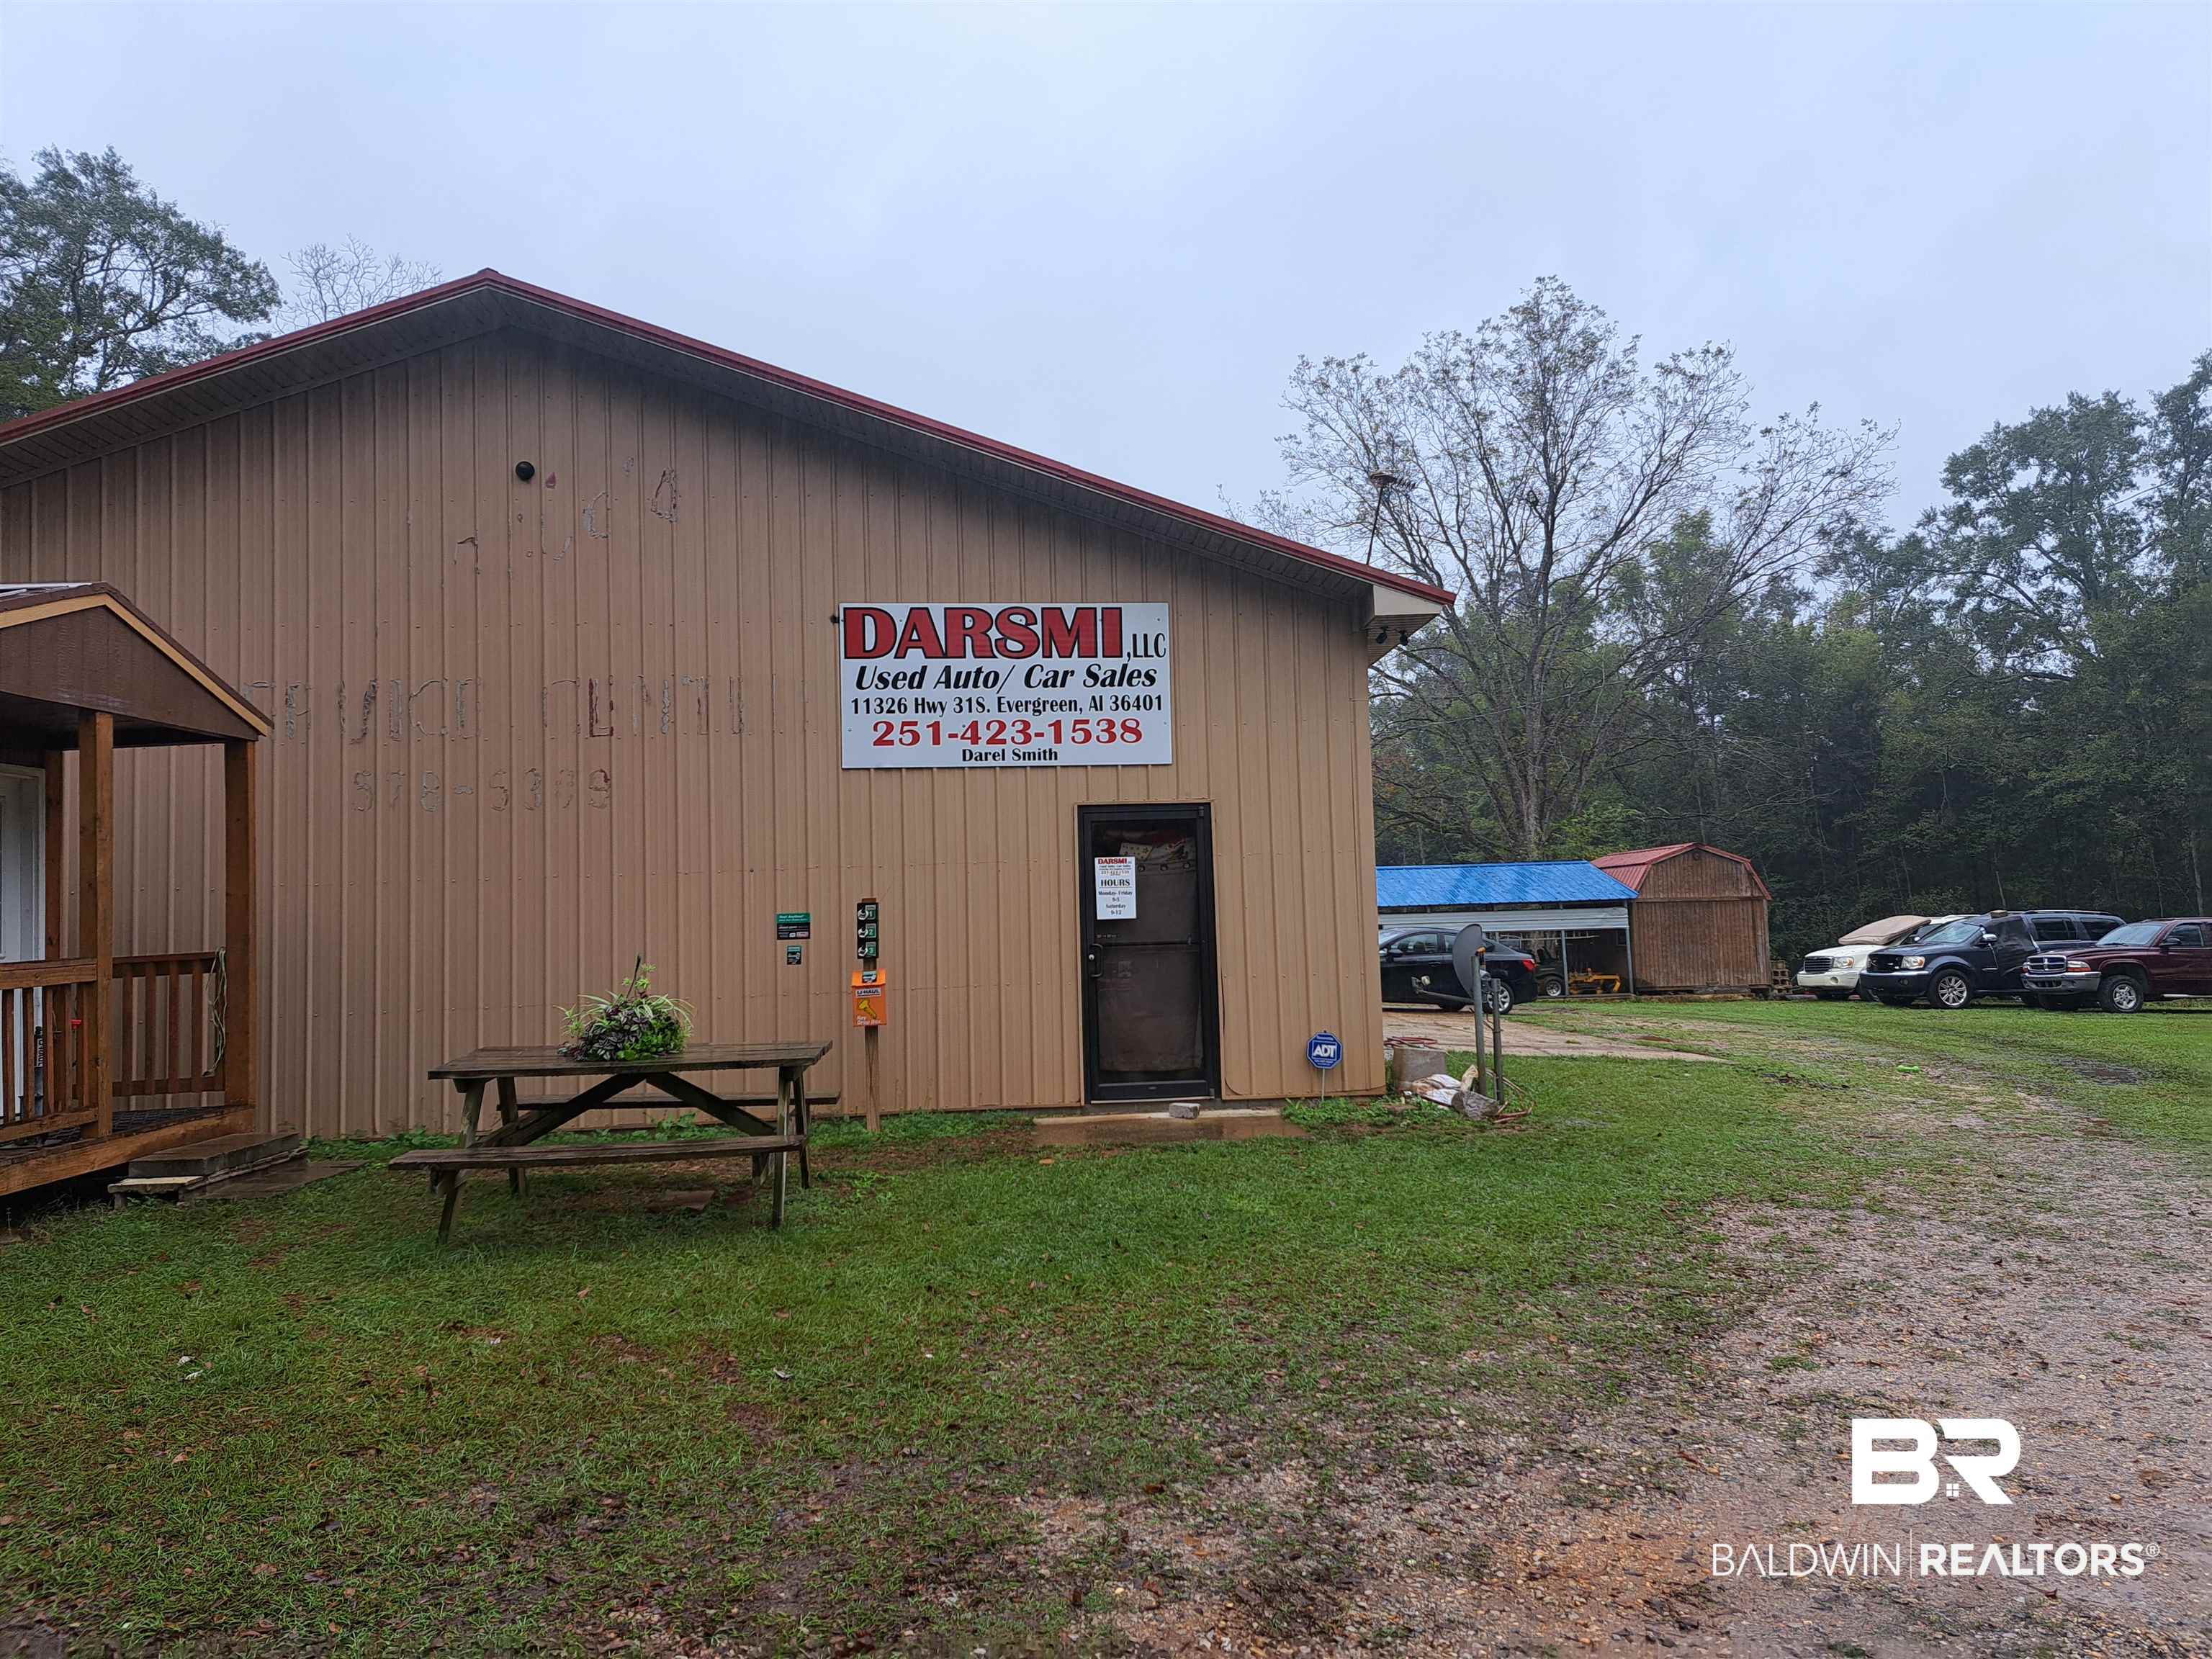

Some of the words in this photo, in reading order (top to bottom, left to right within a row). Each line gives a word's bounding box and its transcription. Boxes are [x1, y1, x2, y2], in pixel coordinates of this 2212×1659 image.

[843, 607, 1123, 659] DARSMI
[855, 665, 927, 691] Used
[934, 665, 1015, 693] Auto/
[1024, 663, 1075, 689] Car
[1082, 662, 1157, 688] Sales
[851, 697, 908, 715] 11326
[914, 696, 948, 717] Hwy
[953, 696, 991, 714] 31S.
[997, 695, 1083, 716] Evergreen,
[1109, 694, 1163, 712] 36401
[872, 718, 1143, 747] 251-423-1538
[962, 748, 1006, 763] Darel
[1012, 747, 1058, 762] Smith
[1313, 1044, 1336, 1058] ADT
